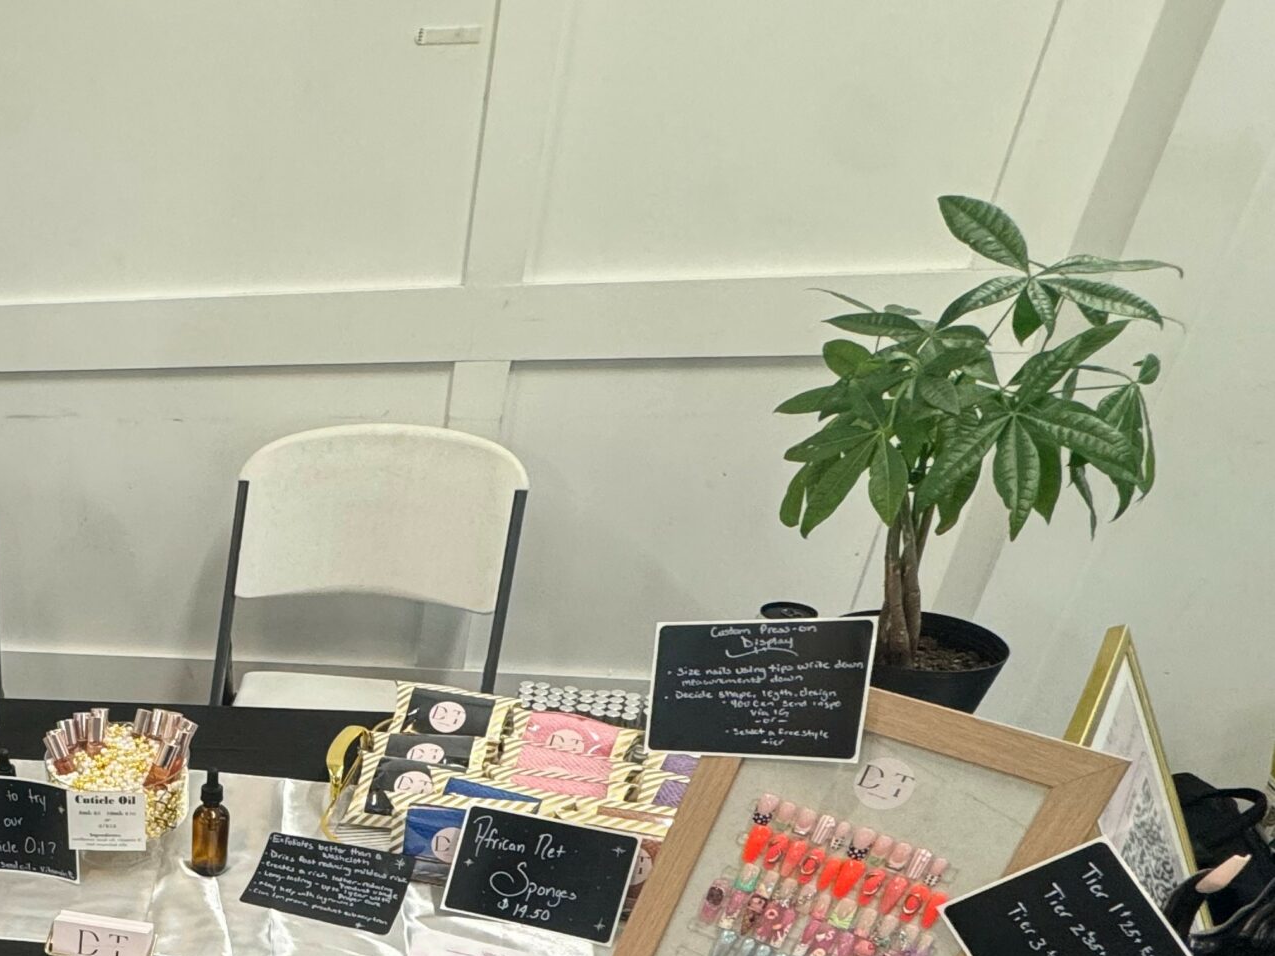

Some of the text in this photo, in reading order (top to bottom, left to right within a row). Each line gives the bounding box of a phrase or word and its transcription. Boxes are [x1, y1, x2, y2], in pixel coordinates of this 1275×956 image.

[710, 626, 752, 638] Custom
[741, 636, 794, 649] Display
[705, 667, 733, 675] nails
[735, 666, 766, 680] using
[768, 662, 794, 675] tips
[834, 659, 864, 670] down
[770, 673, 804, 682] down
[6, 790, 18, 801] to
[29, 788, 46, 811] try
[75, 795, 136, 804] Cuticle Oil
[3, 817, 23, 827] our
[272, 835, 314, 850] Exfoliates
[318, 844, 347, 854] better
[350, 848, 372, 858] than
[474, 815, 566, 860] African Net
[270, 850, 295, 862] Dries
[489, 862, 577, 907] Sponges
[1081, 861, 1109, 898] Tier
[1043, 881, 1073, 917] Tier
[1007, 901, 1036, 934] Tier
[1028, 937, 1047, 951] 3
